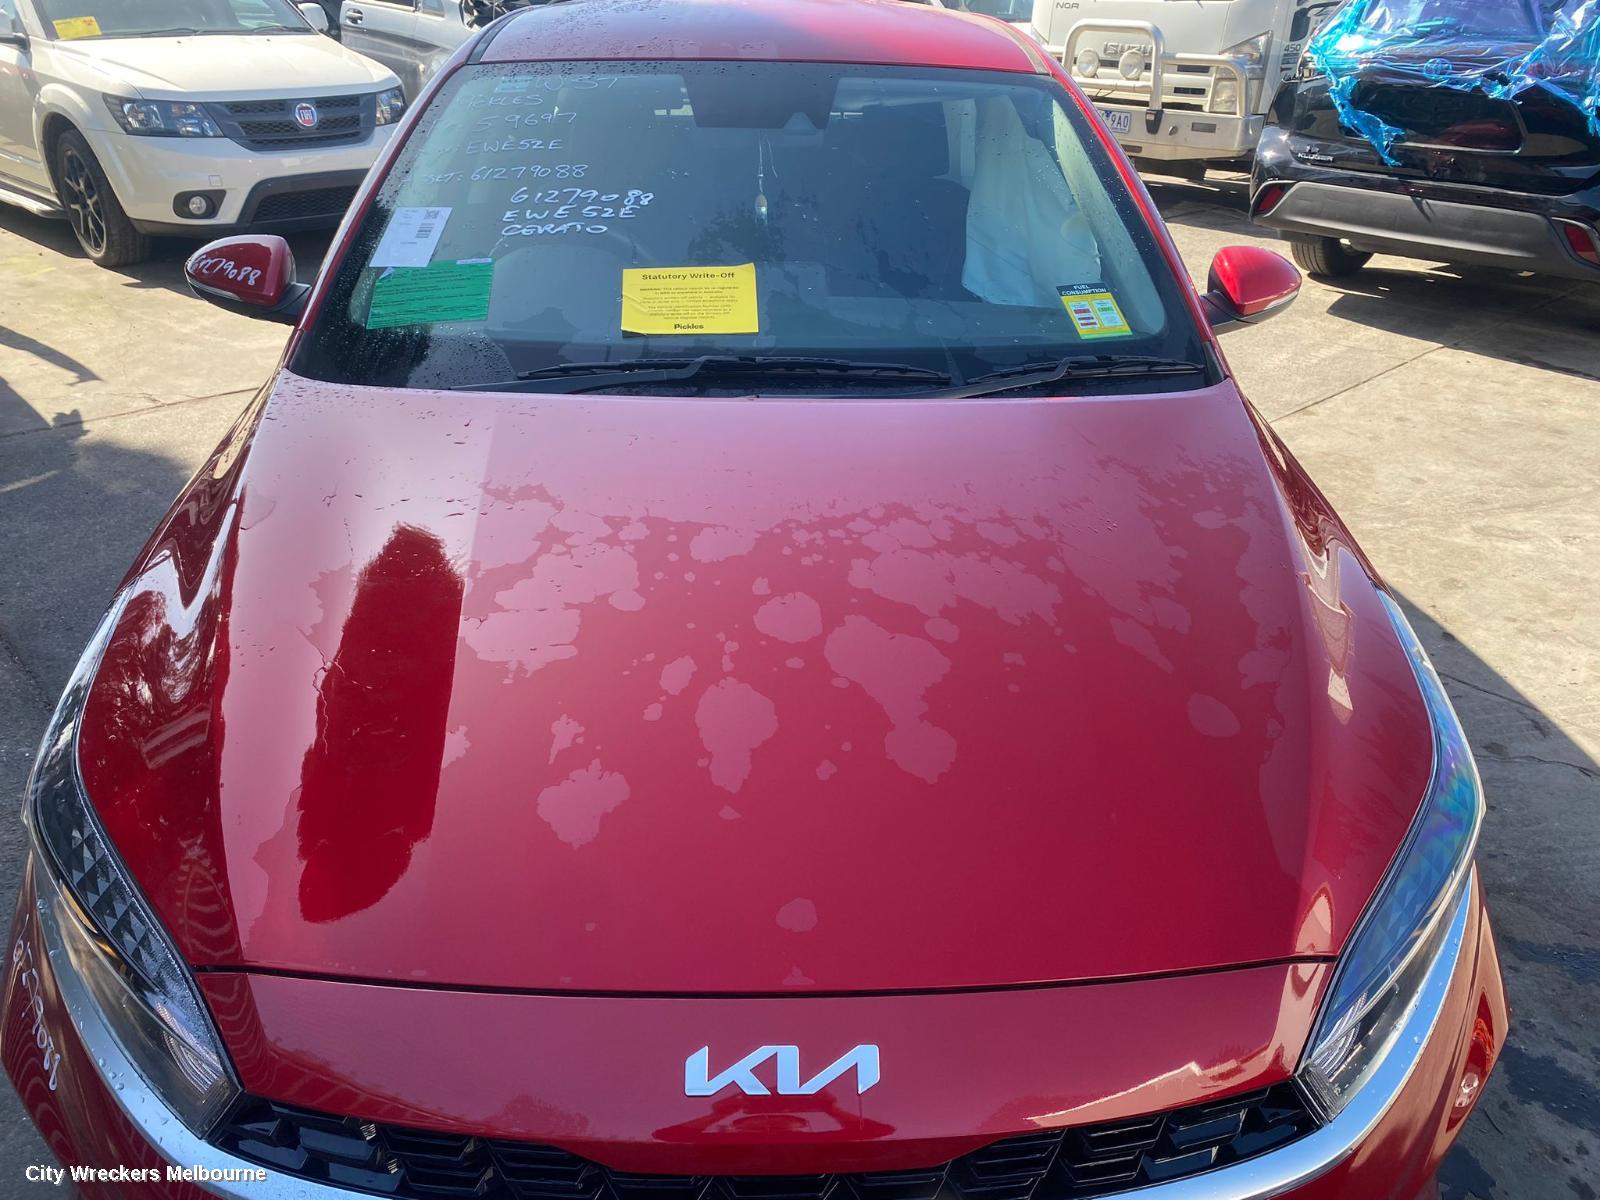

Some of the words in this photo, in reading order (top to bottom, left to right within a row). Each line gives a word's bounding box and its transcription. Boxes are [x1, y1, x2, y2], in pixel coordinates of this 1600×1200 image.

[471, 163, 589, 182] 61279088
[510, 186, 655, 206] 61279088
[502, 221, 608, 236] CERATO
[641, 273, 687, 281] Statutory
[690, 271, 735, 279] Write-Off
[1061, 287, 1107, 296] CONSUMPTION
